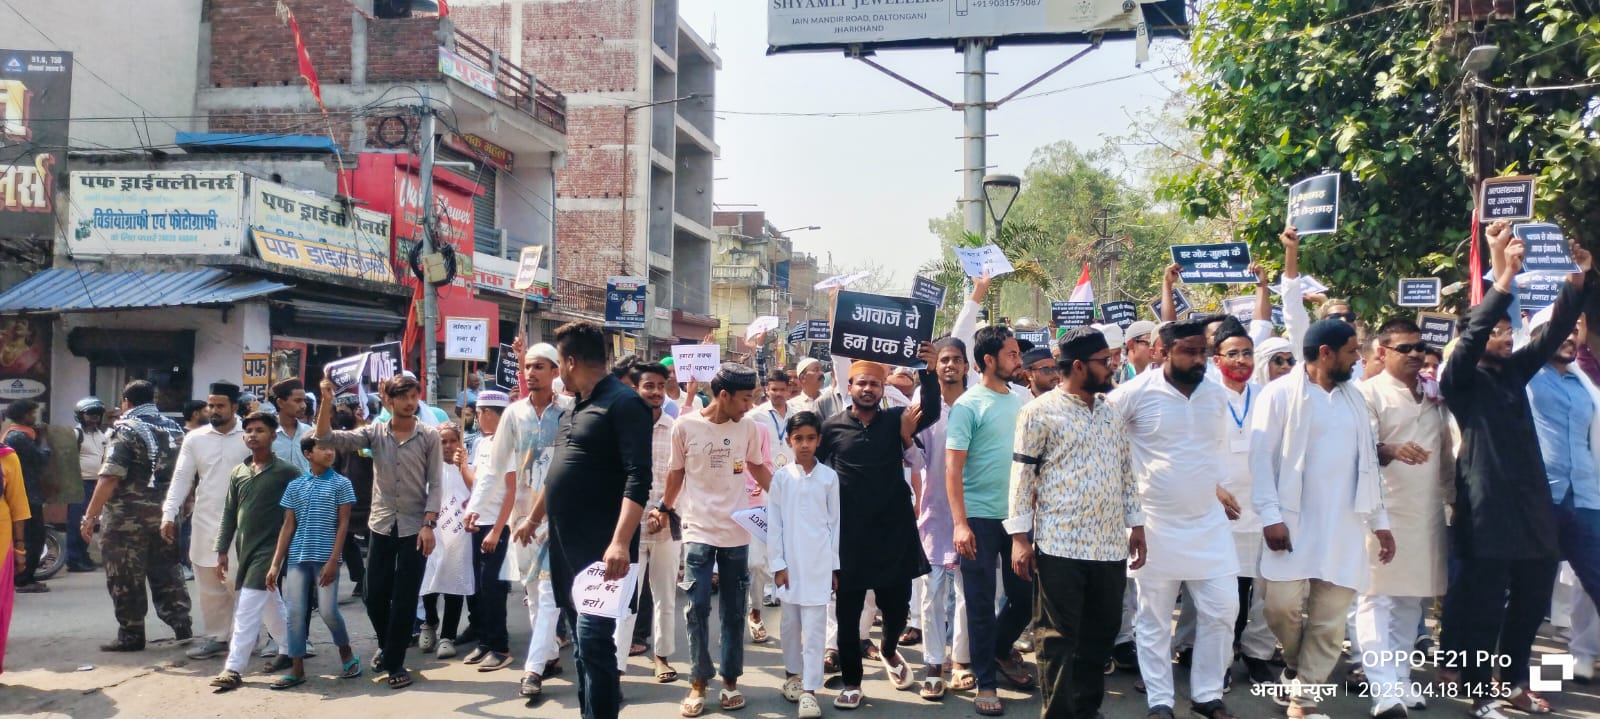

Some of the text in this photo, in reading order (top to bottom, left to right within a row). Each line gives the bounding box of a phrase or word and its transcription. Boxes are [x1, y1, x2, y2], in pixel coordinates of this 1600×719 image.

[791, 12, 928, 25] JAIN MANDIR ROAD, DALTONGANJ
[834, 25, 884, 34] JHARKHAND
[80, 173, 237, 192] पफ ड्राईक्लीनर्स
[852, 304, 921, 330] आवाज दो
[843, 332, 869, 352] हम
[872, 336, 901, 355] एक
[582, 597, 604, 609] करो।
